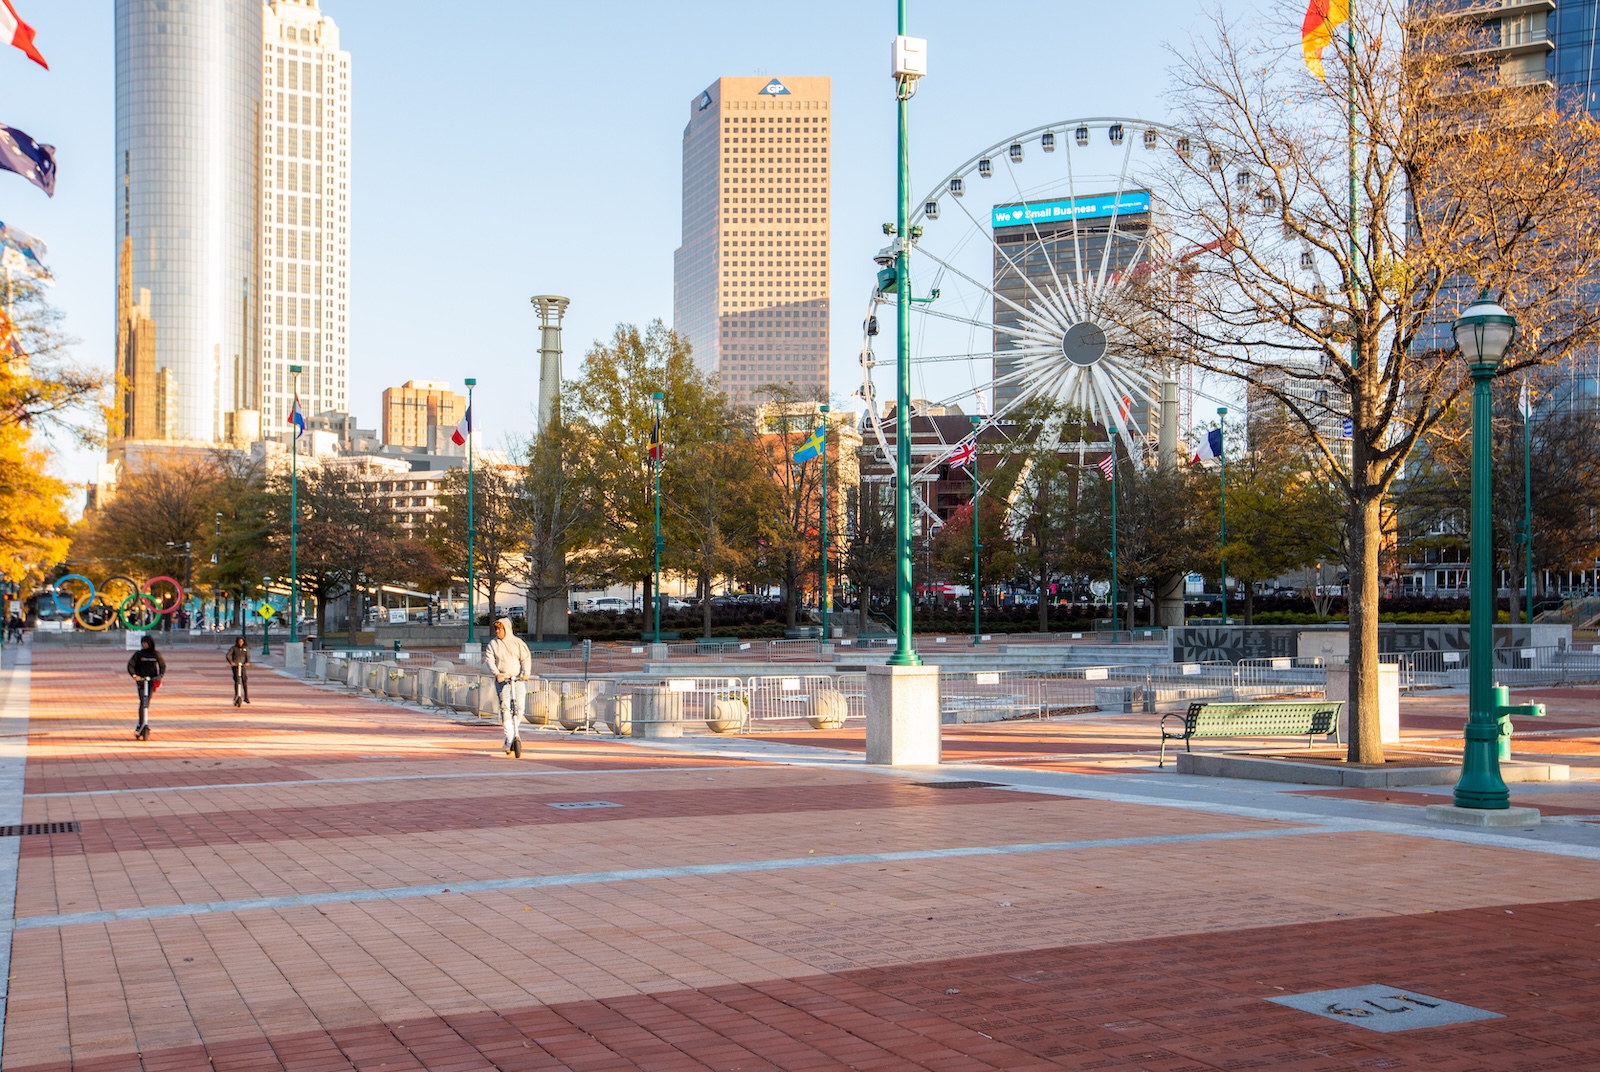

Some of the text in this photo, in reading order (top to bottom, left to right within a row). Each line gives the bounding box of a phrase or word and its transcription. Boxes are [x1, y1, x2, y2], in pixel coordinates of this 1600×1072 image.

[766, 84, 784, 93] GP
[995, 204, 1097, 221] We Small Busness
